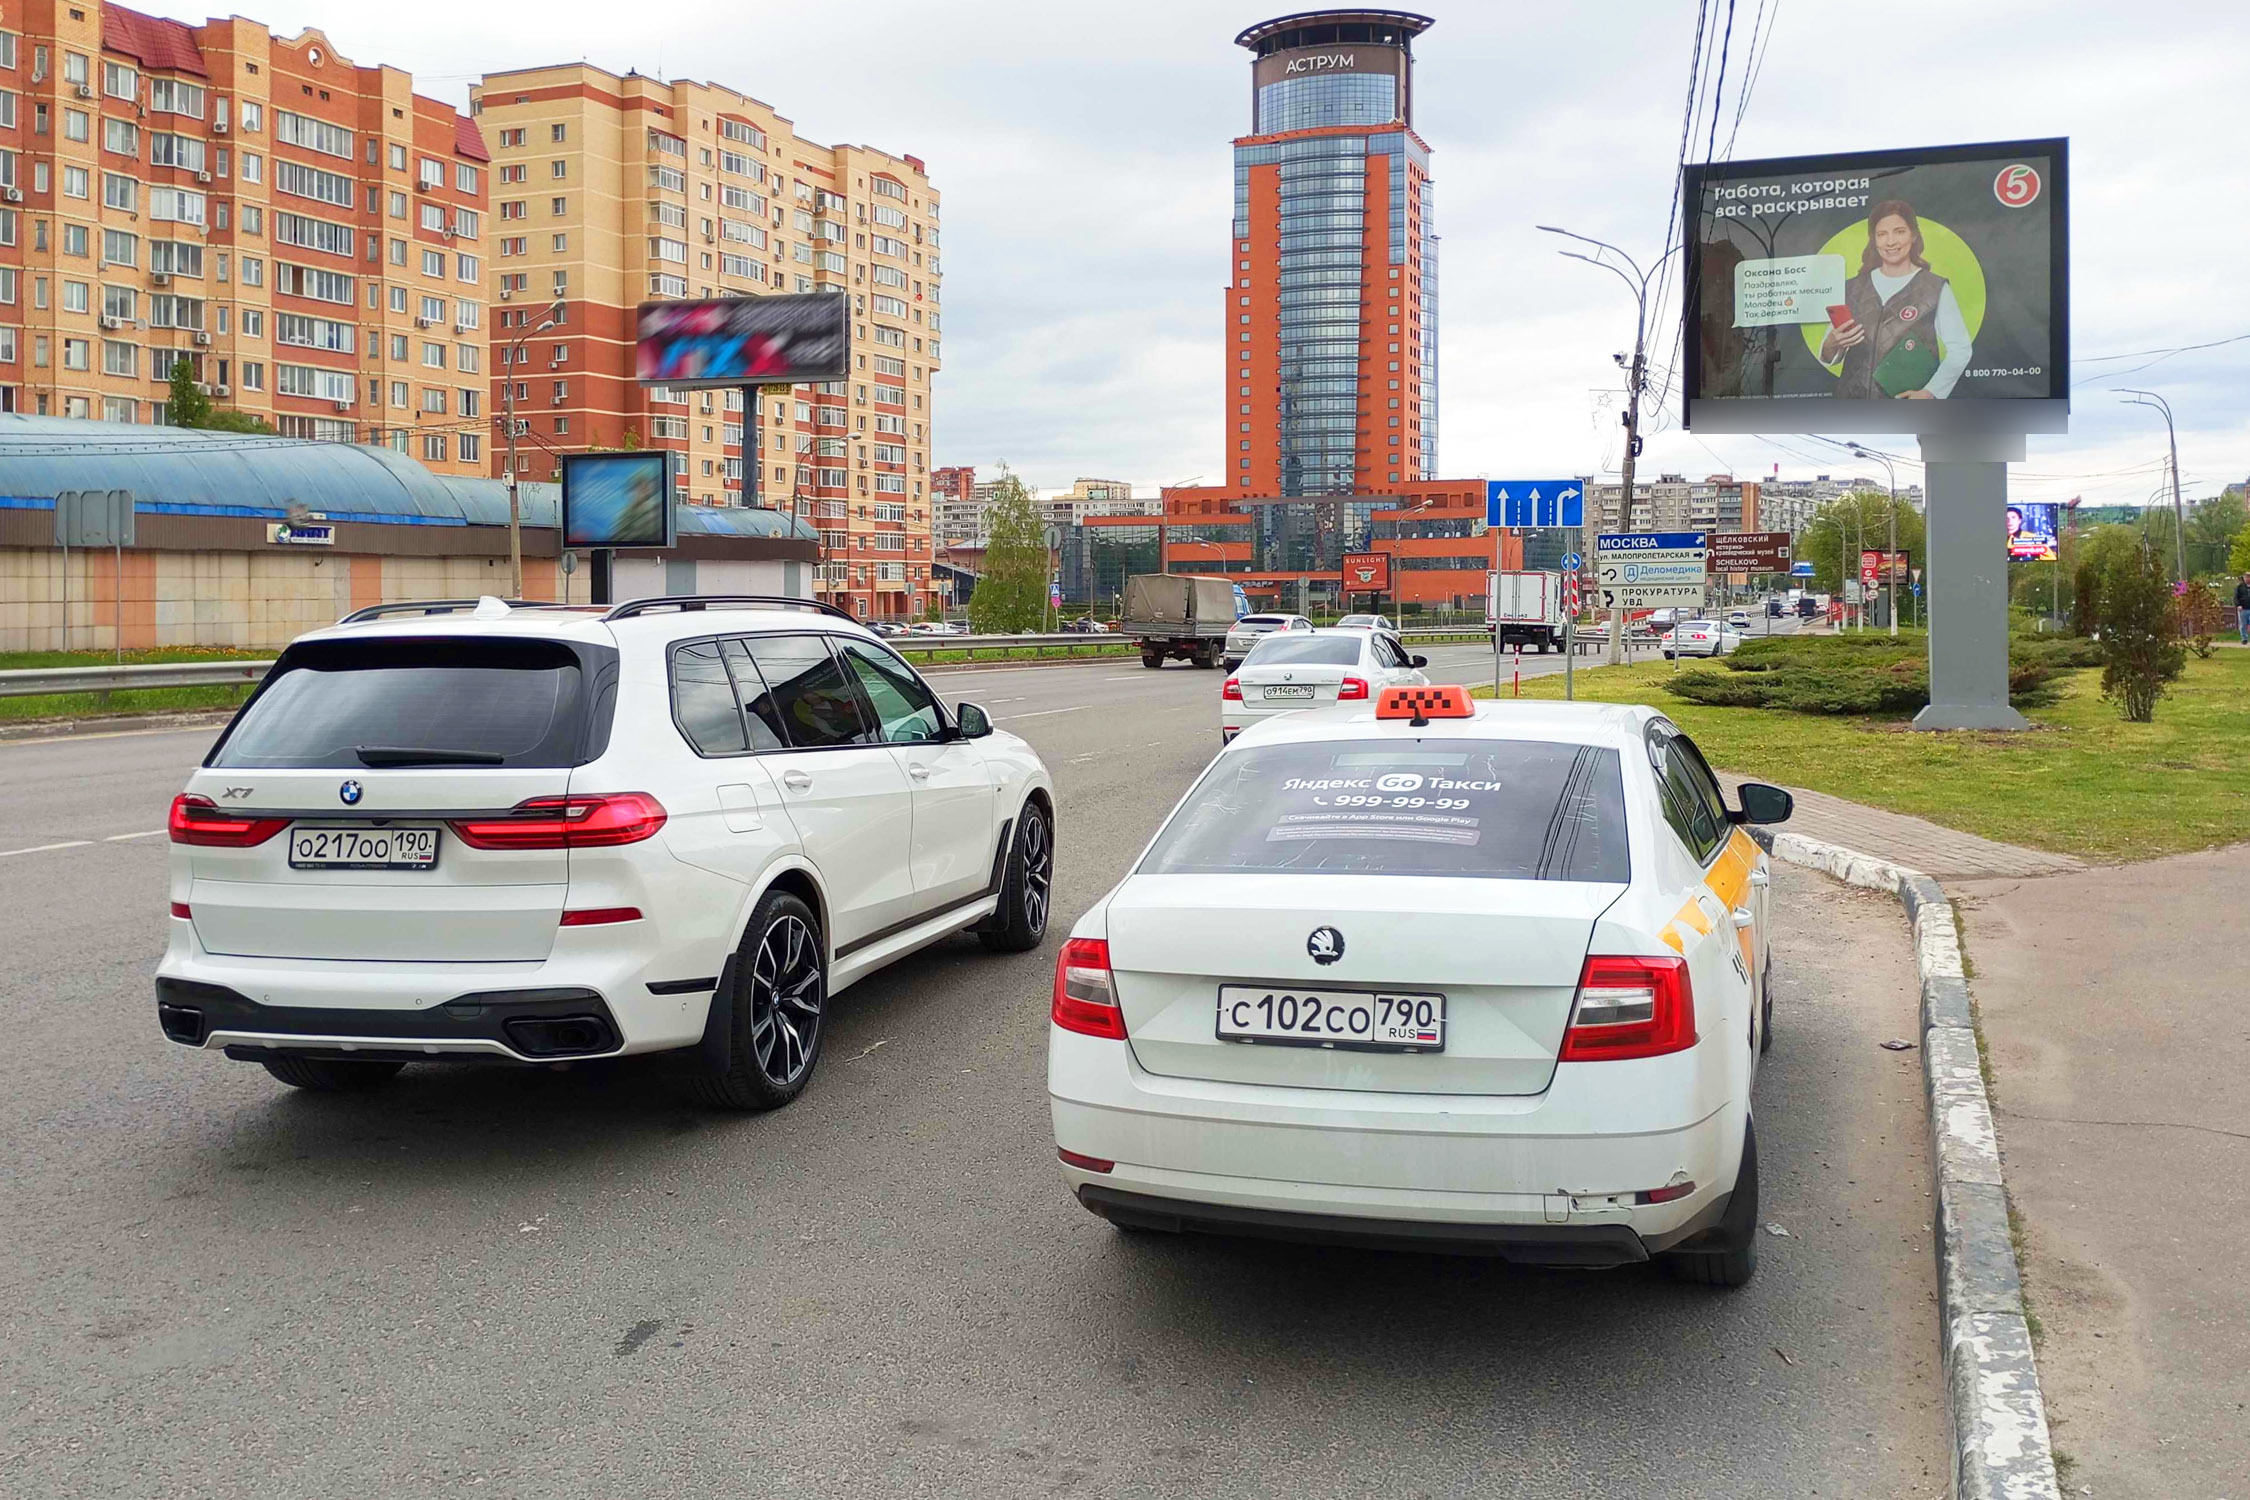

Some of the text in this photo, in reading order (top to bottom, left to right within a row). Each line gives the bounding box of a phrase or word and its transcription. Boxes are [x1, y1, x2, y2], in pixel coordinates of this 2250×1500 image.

[1286, 54, 1354, 74] АСТРУМ
[1715, 177, 1870, 202] Работа, которая
[1715, 195, 1869, 218] вас раскрывает
[1744, 266, 1807, 278] Оксана Босс
[1744, 280, 1798, 290] Поздравляю,
[1757, 288, 1797, 300] работник
[1799, 287, 1833, 295] месяца!
[1744, 299, 1783, 309] Молодец
[1745, 307, 1799, 318] Так держать!
[1965, 366, 2041, 378] 8 800 770-04-00
[1600, 537, 1658, 549] МОСКВА
[1716, 534, 1769, 544] ЩЁЛКОВСКИЙ
[1600, 552, 1690, 561] ул. МАЛОПРОЛЕТАРСКАЯ
[1640, 564, 1702, 576] Деломедика
[1622, 588, 1698, 596] ПРОКУРАТУРА
[1623, 598, 1643, 606] УВД
[1281, 776, 1502, 792] Яндекс Go Такси
[222, 787, 254, 799] X7
[1334, 795, 1471, 810] 999-99-99
[1415, 815, 1449, 823] Google
[1450, 817, 1472, 825] Play
[299, 832, 429, 859] О217ОО 190
[401, 852, 419, 860] RUS
[1231, 994, 1433, 1034] С102СО 790
[1388, 1027, 1416, 1039] RUS
